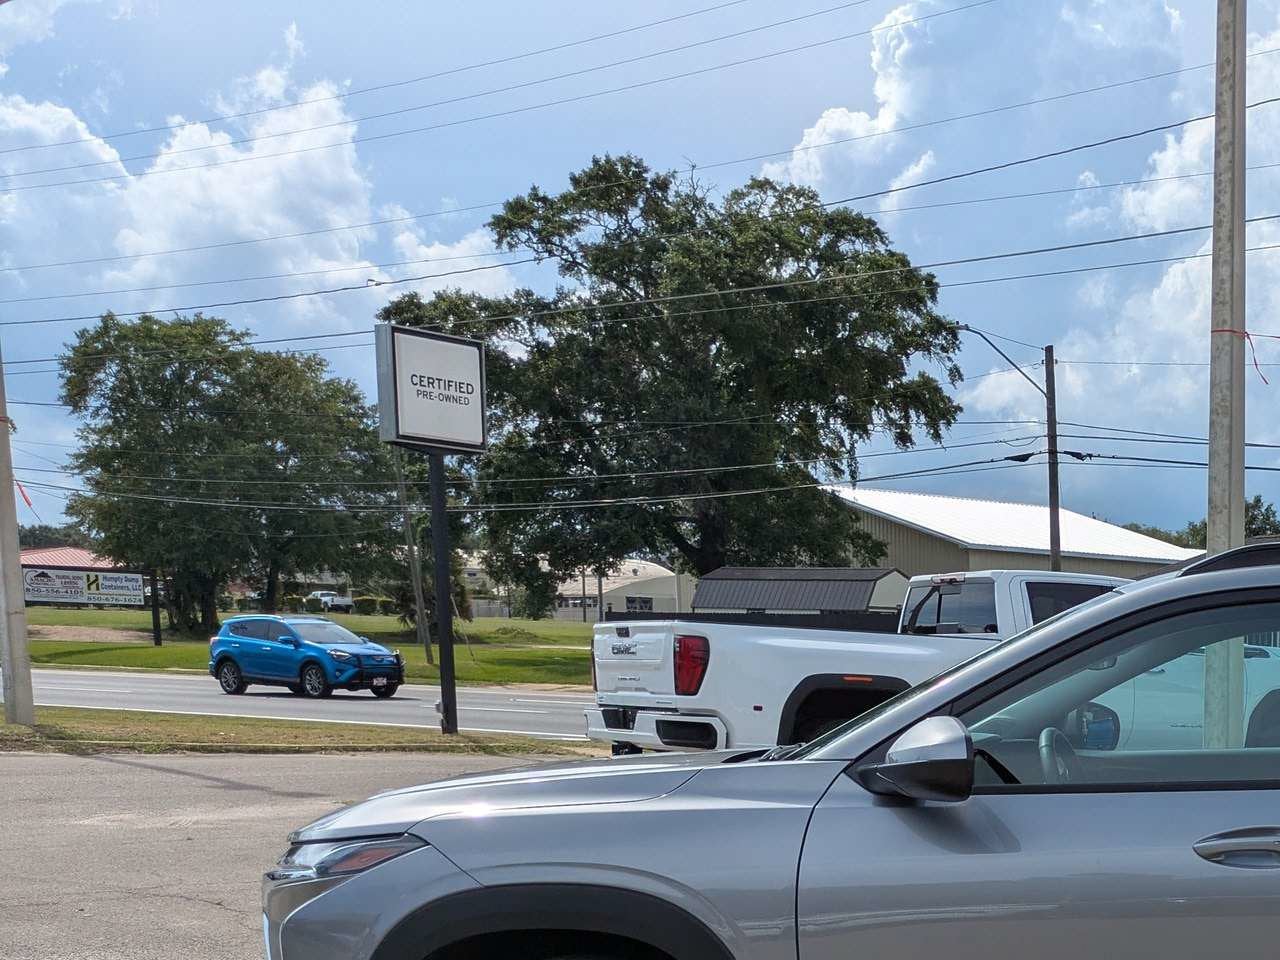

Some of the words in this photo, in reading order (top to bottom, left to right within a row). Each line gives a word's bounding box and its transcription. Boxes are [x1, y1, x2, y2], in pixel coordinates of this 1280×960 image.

[410, 374, 474, 395] CERTIFIED
[416, 389, 470, 405] PRE-OWNED
[102, 575, 123, 584] Humpty
[124, 576, 139, 584] Dump
